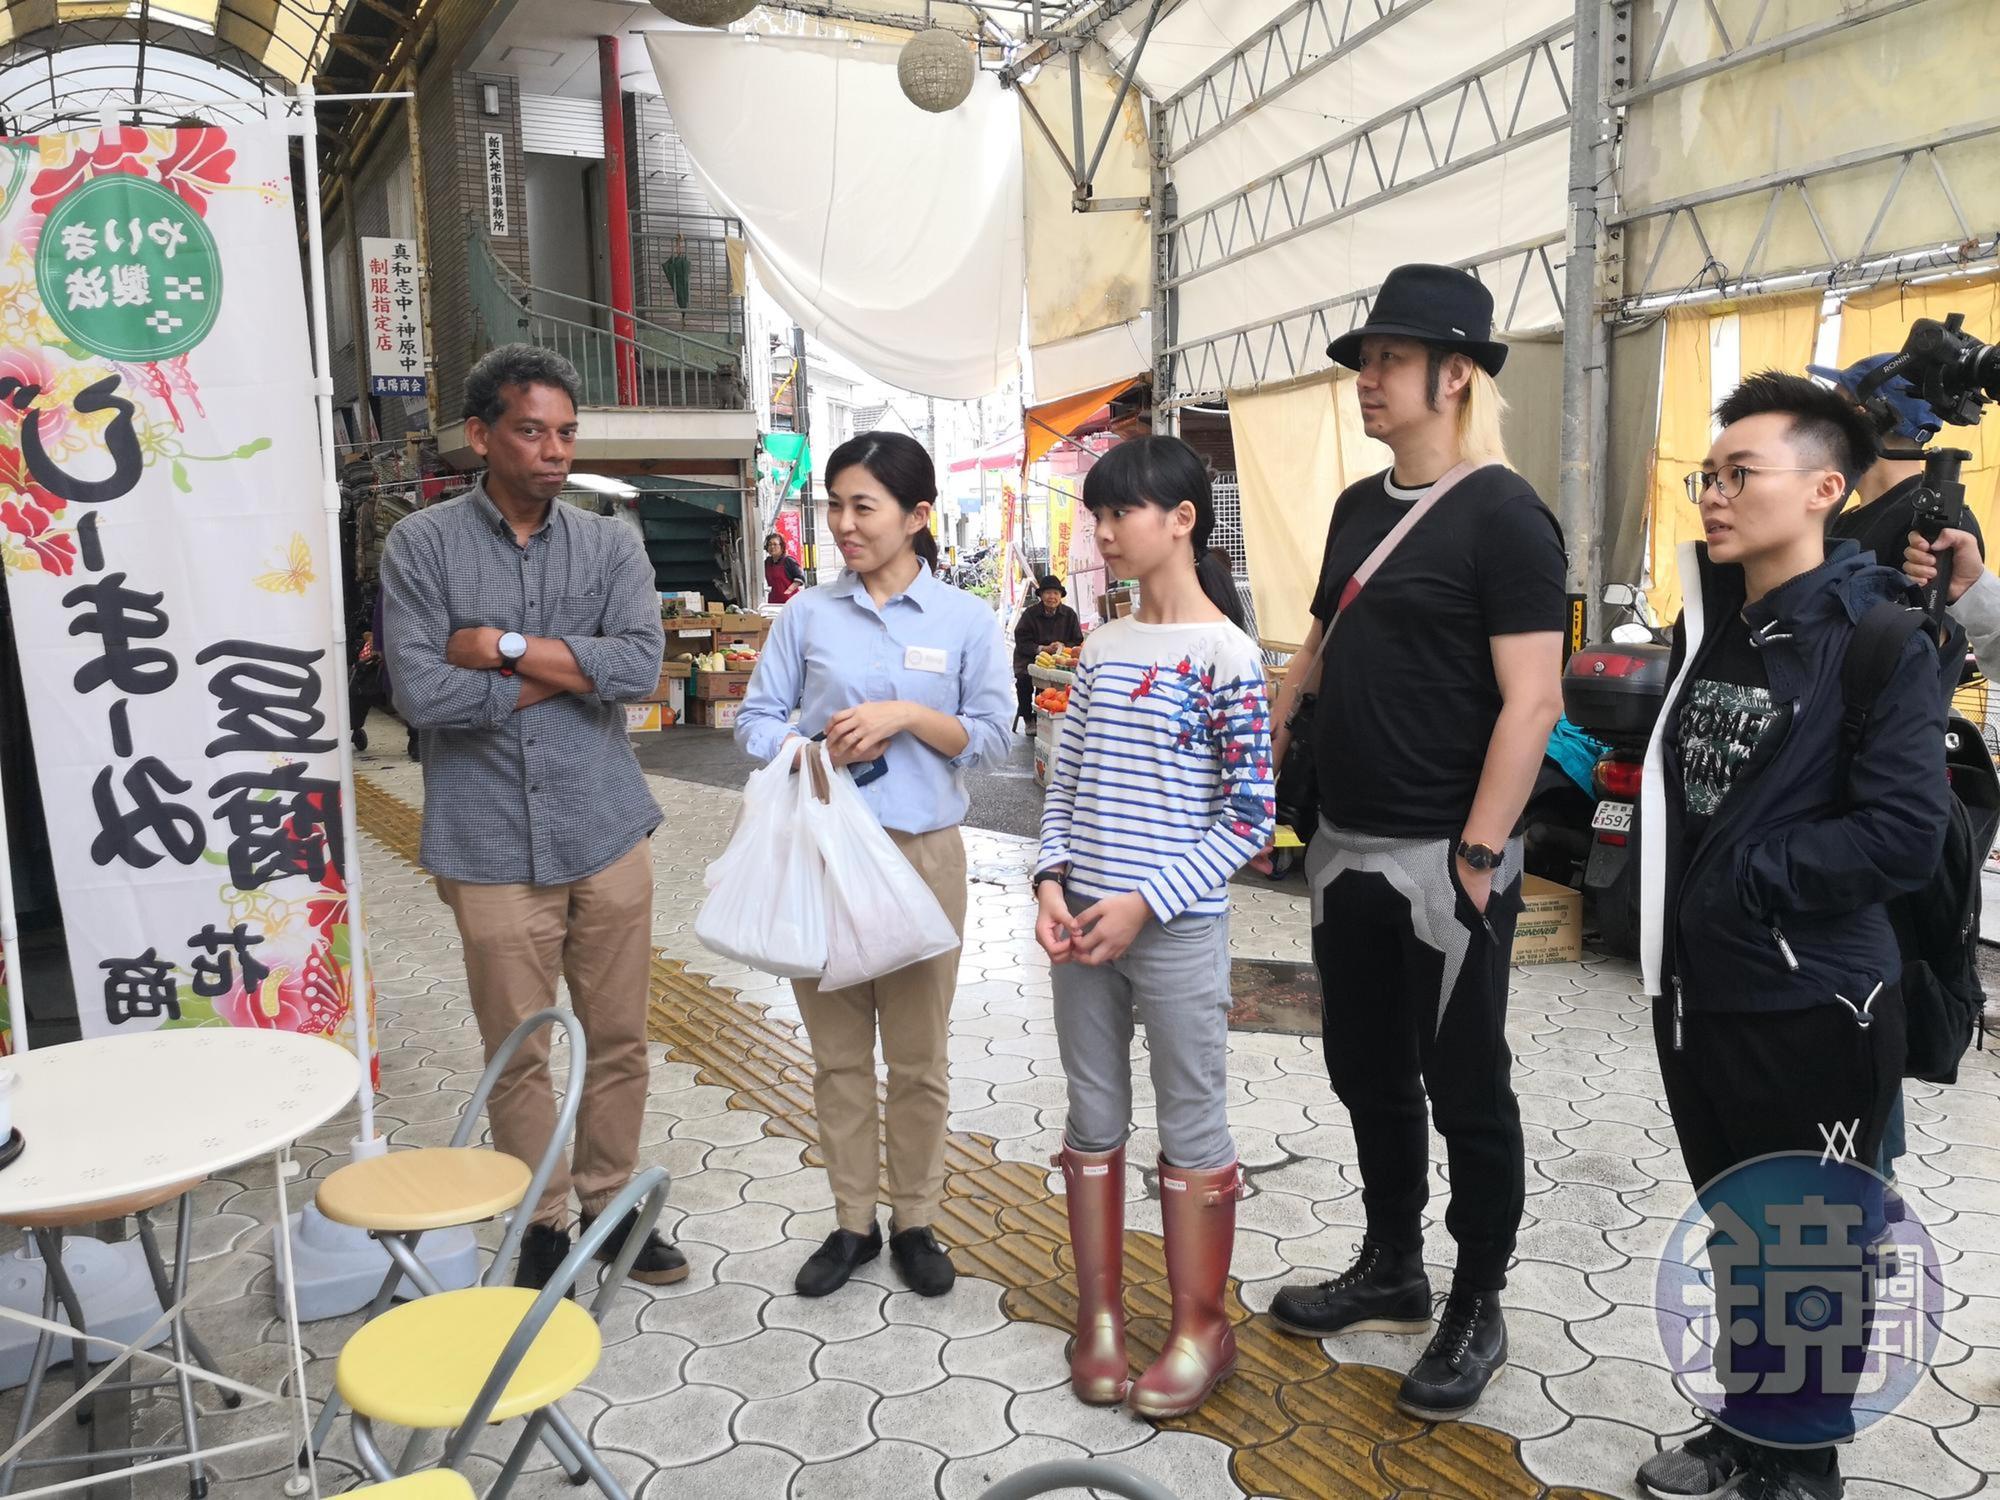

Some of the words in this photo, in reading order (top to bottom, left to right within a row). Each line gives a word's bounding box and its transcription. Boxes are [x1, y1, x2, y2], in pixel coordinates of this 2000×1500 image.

[488, 136, 505, 232] 新天地市場事務所
[369, 257, 393, 352] 制服指定店
[391, 243, 417, 373] 真和志中・神原中
[375, 377, 422, 393] 真陽商会
[1883, 352, 1911, 374] RONIN
